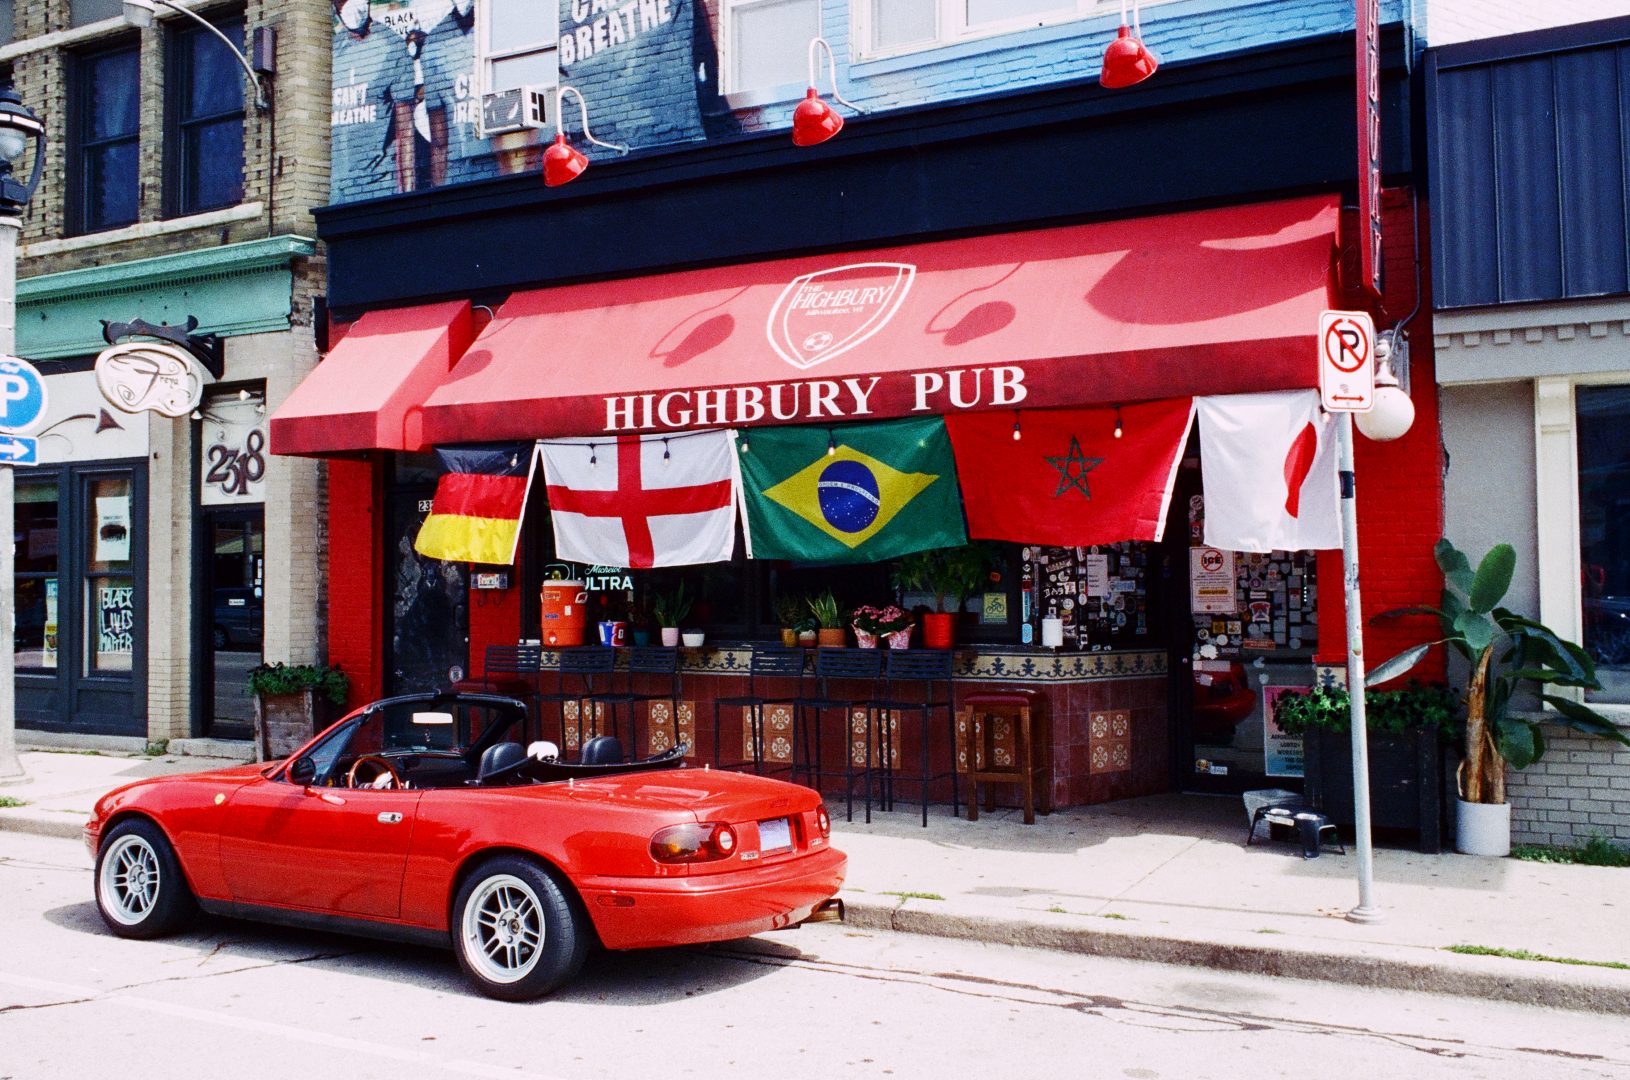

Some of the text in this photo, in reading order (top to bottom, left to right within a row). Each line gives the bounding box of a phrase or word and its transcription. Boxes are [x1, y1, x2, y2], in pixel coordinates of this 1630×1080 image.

[384, 11, 415, 27] BLACK
[560, 0, 672, 66] BREATHE
[791, 286, 893, 310] HIGHBURY
[803, 285, 824, 293] THE
[0, 373, 29, 418] P
[602, 365, 1028, 431] HIGHBURY PUB
[206, 429, 265, 495] 2318
[419, 501, 434, 511] 23
[1203, 556, 1222, 565] ICE
[102, 588, 133, 609] BLACK
[101, 610, 133, 634] LIVES
[100, 631, 133, 652] MATTER
